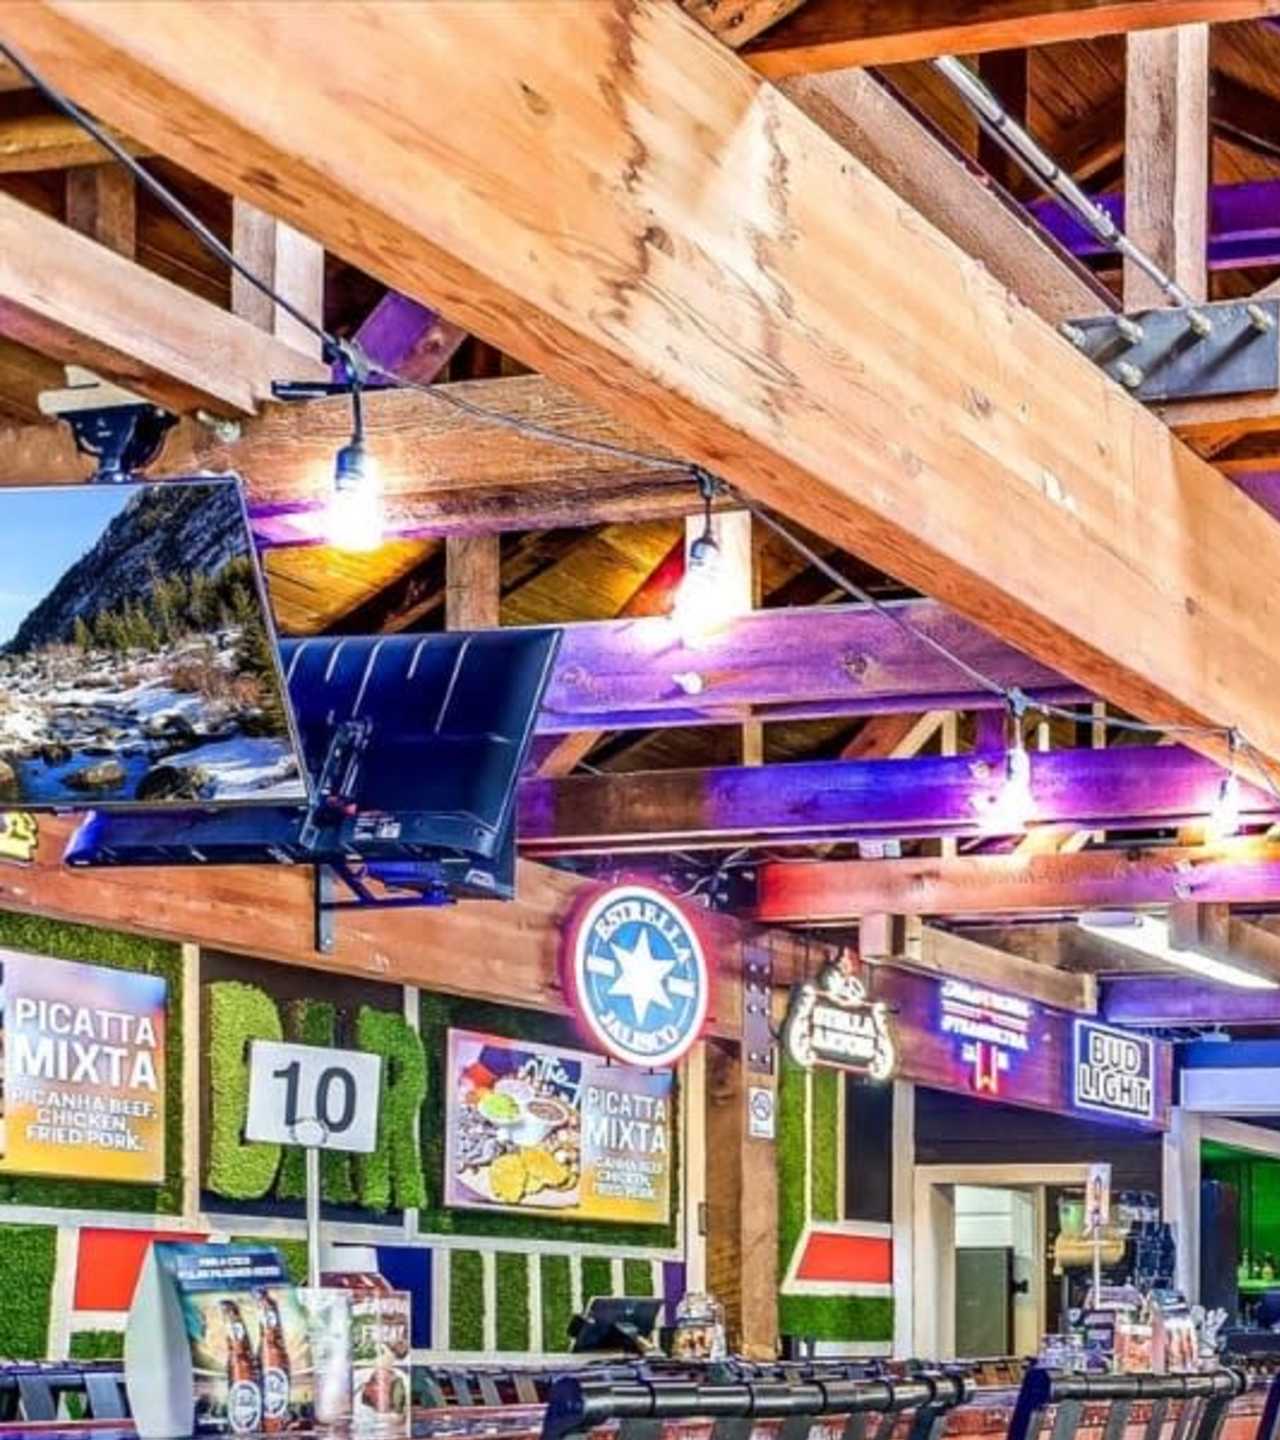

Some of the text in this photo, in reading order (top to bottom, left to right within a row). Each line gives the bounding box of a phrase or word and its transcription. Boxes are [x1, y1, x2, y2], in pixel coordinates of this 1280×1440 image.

[594, 900, 692, 964] ESTRELLA
[15, 997, 157, 1048] PICATTA
[600, 1009, 680, 1050] JALISCO
[13, 1033, 160, 1092] MIXTA
[1088, 1030, 1141, 1074] BUD
[272, 1060, 357, 1134] 10
[585, 1086, 667, 1122] PICATTA
[1079, 1062, 1151, 1114] LIGHT
[25, 1124, 83, 1145] FRIED
[585, 1114, 668, 1153] MIXTA
